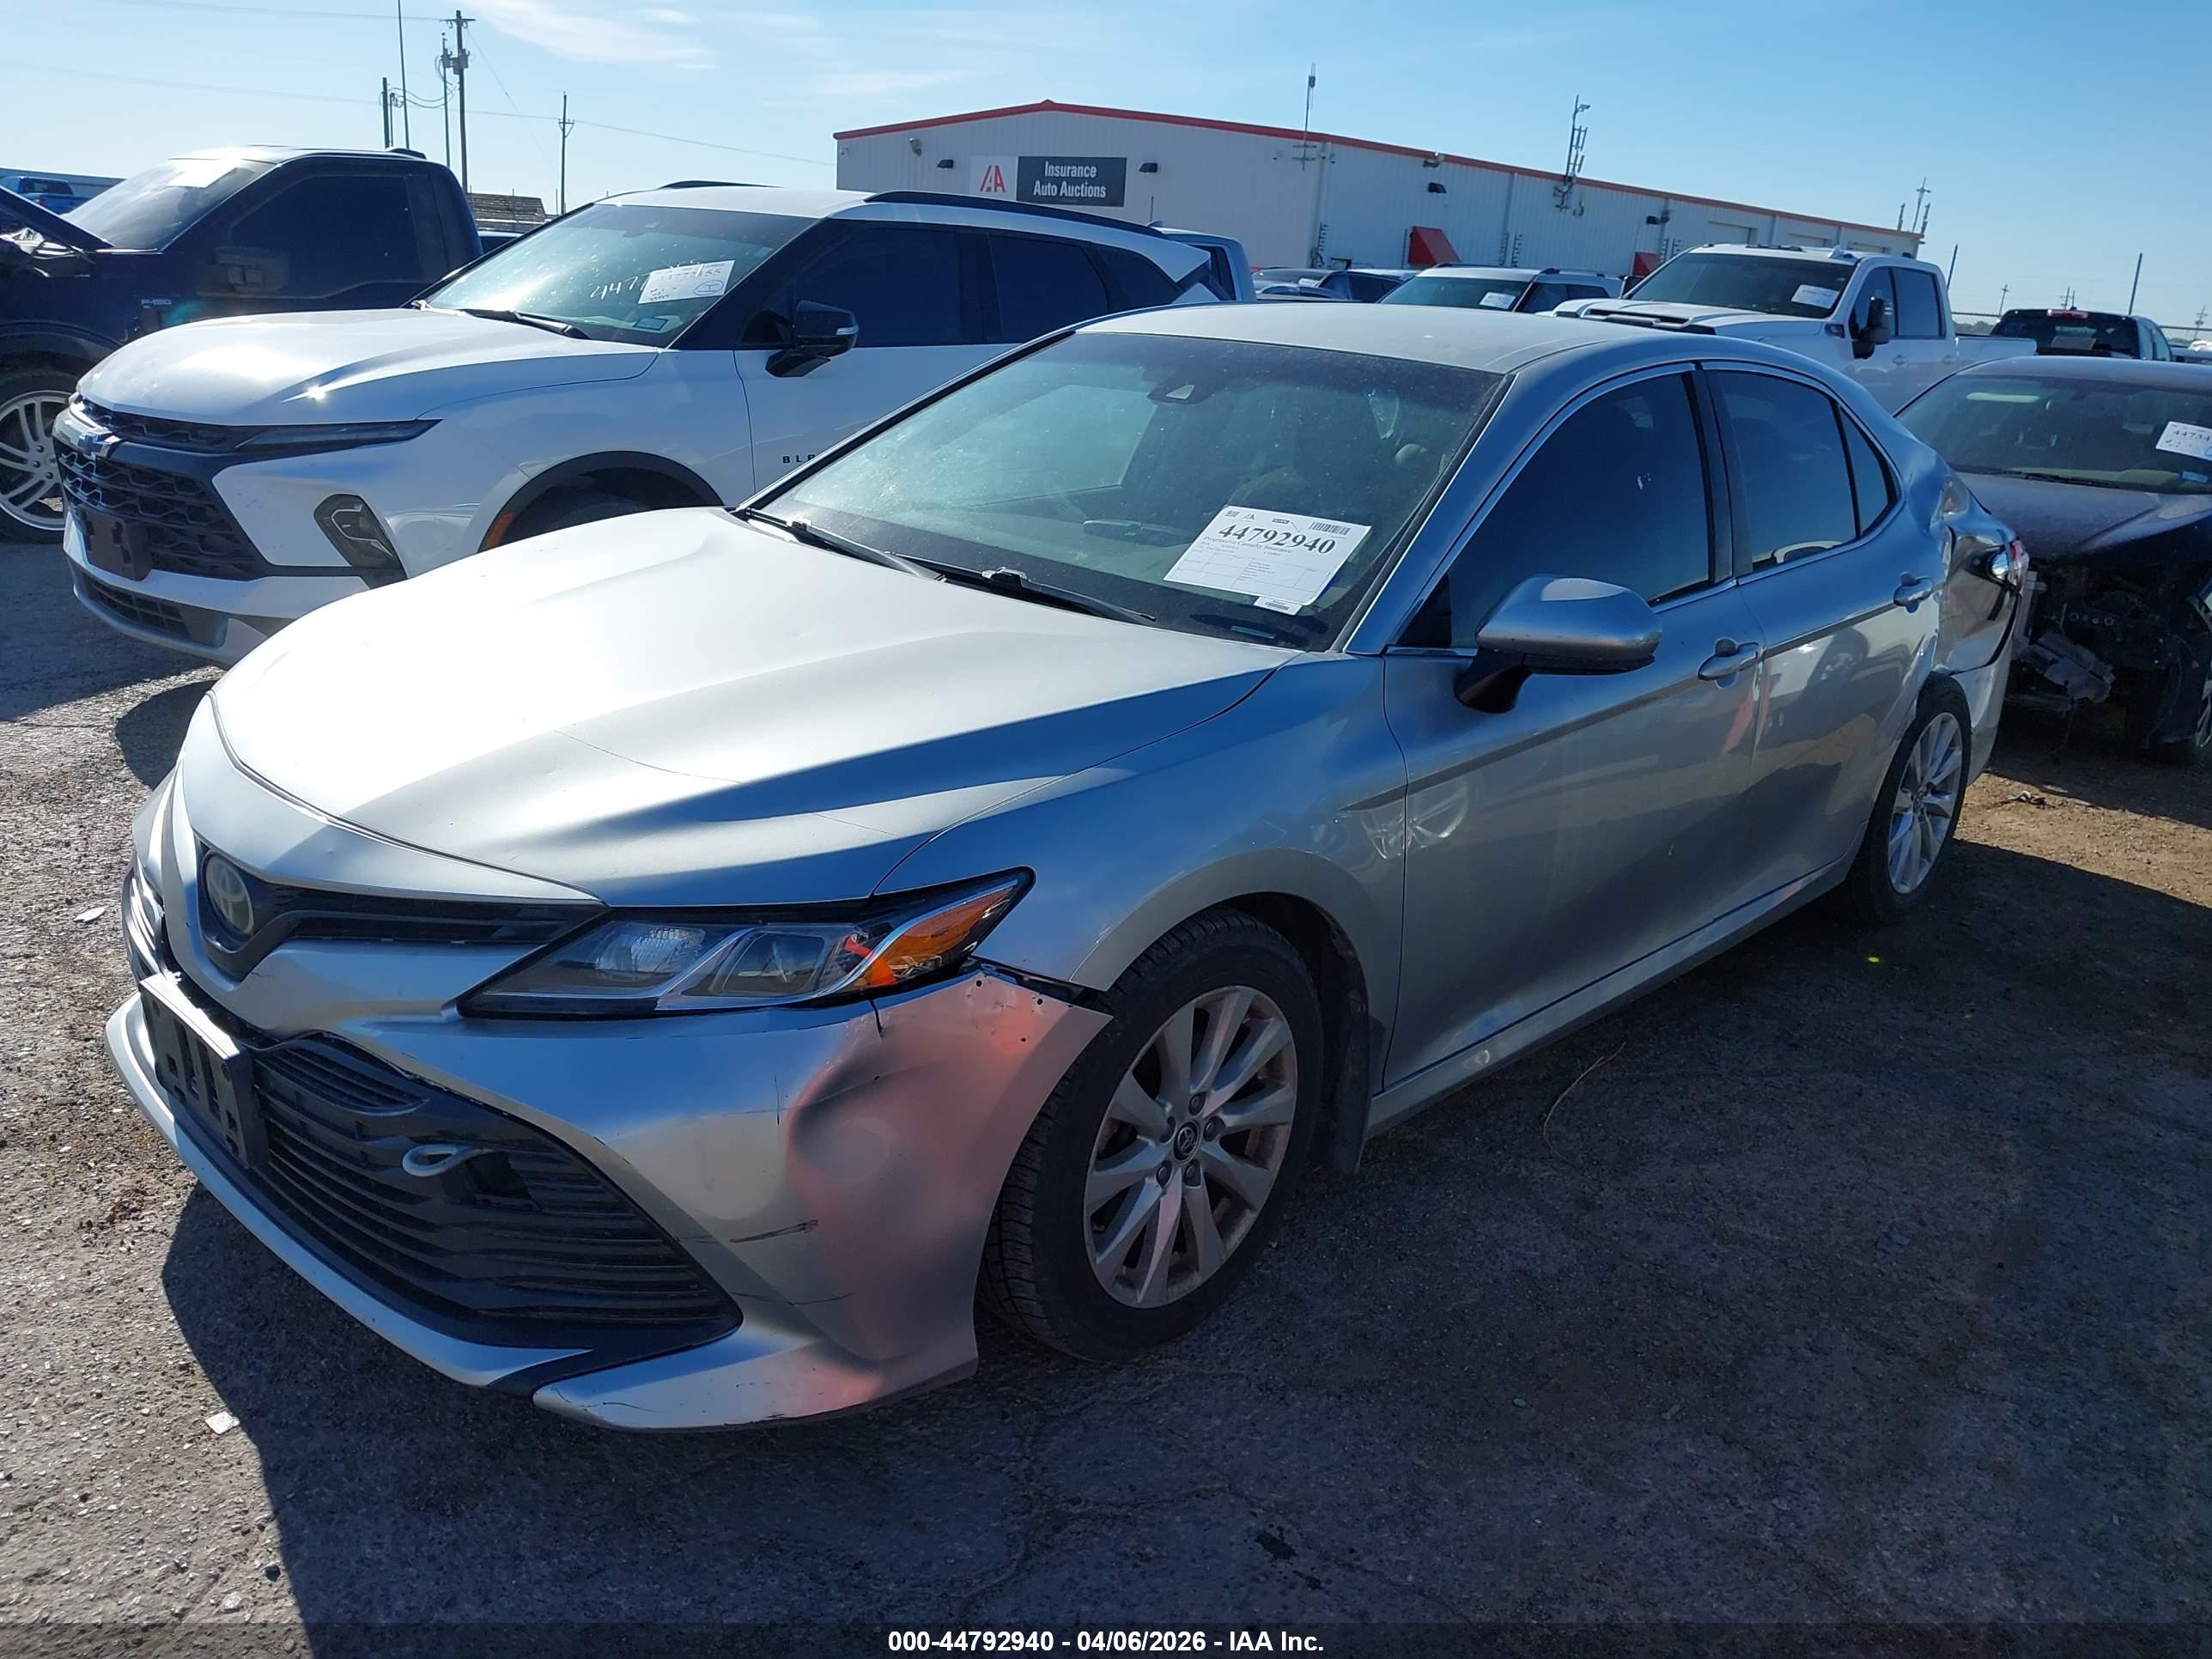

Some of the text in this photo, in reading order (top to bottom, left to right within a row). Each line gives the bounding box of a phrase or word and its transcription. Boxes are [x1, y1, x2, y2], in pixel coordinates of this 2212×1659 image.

[1044, 161, 1097, 179] Insurance
[1033, 180, 1107, 198] Auto Auctions
[1218, 524, 1336, 555] 44792940
